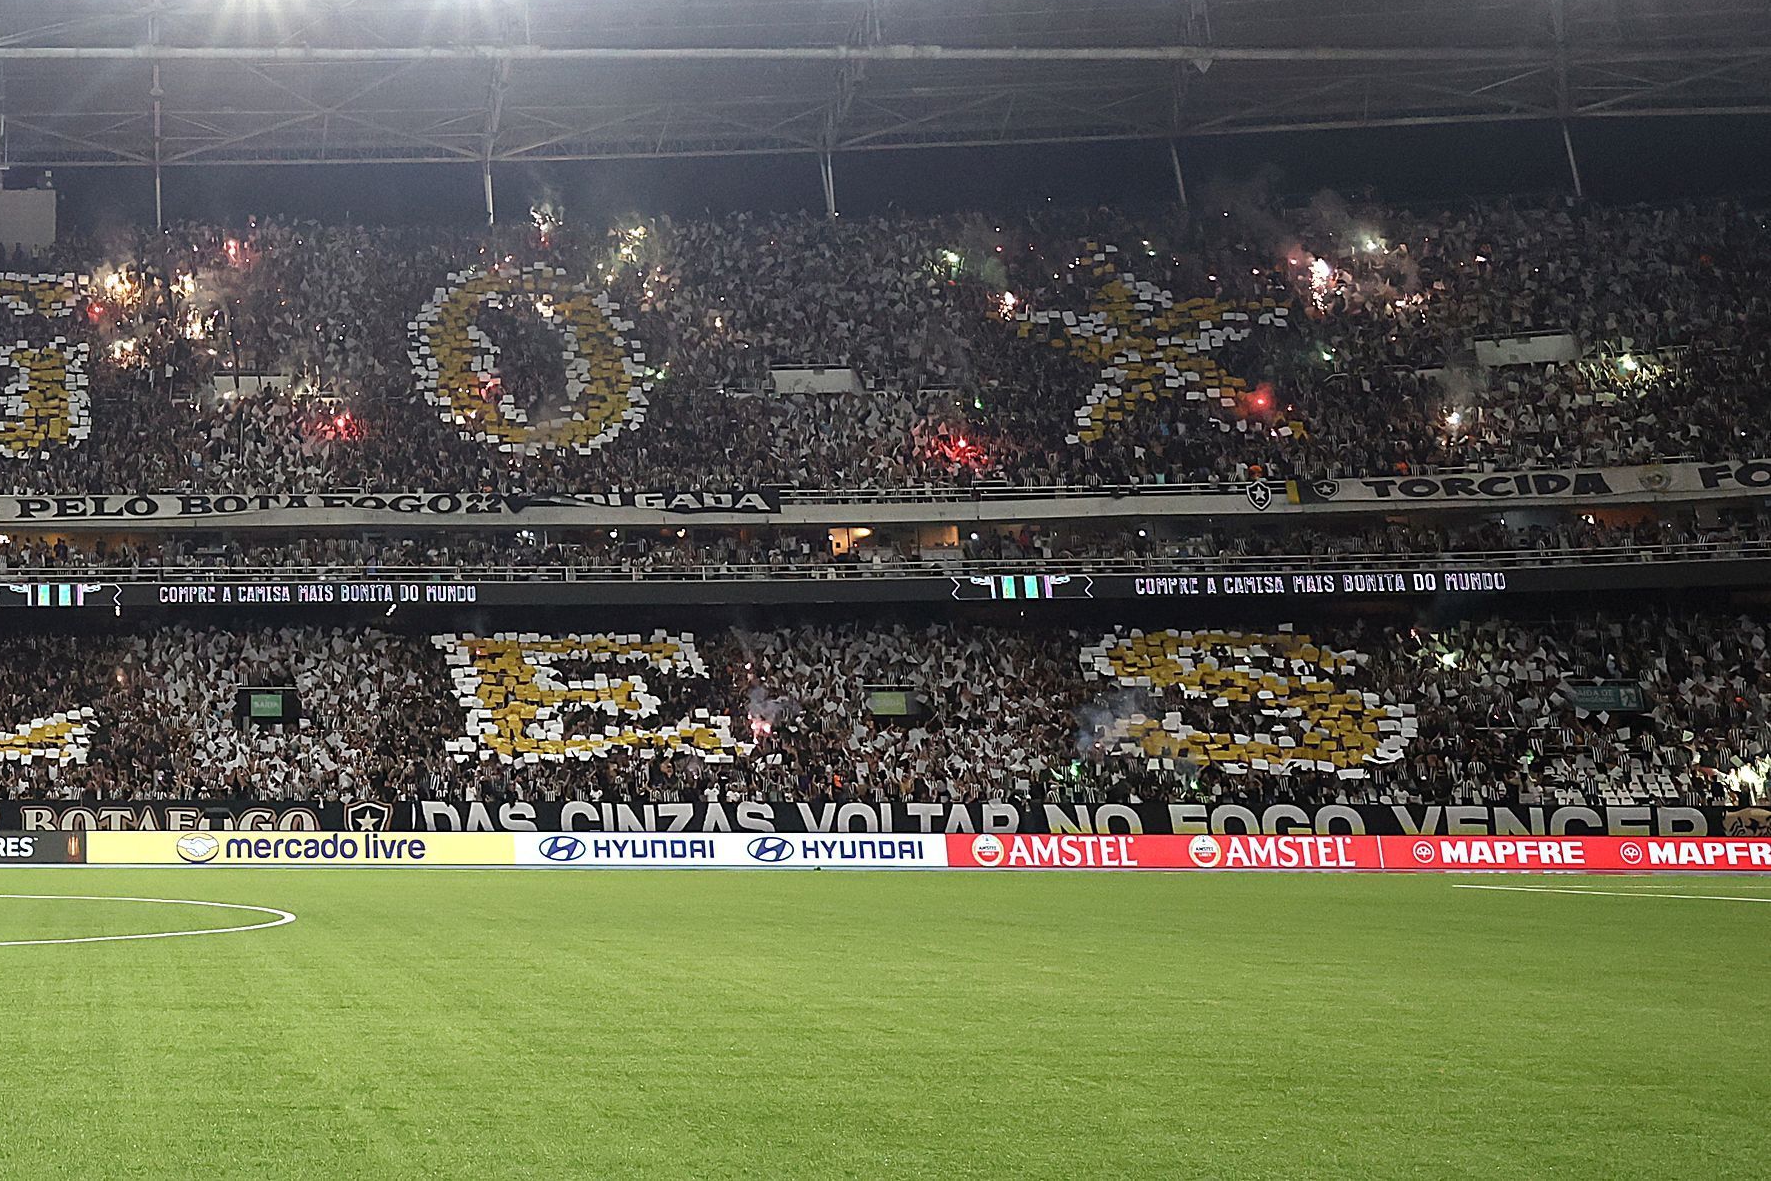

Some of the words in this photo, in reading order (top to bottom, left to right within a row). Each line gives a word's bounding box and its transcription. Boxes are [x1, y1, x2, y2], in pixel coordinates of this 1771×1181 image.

[1366, 473, 1613, 499] TORCIDA
[16, 497, 158, 518] PELO
[159, 585, 216, 603] COMPRE
[221, 585, 232, 603] A
[237, 585, 290, 603] CAMISA
[298, 585, 334, 603] MAIS
[340, 584, 393, 602] BONITA
[399, 584, 419, 602] DO
[426, 584, 477, 602] MUNDO
[1134, 577, 1199, 595] COMPRE
[1207, 577, 1217, 594] A
[1223, 576, 1285, 594] CAMISA
[1292, 575, 1335, 593] MAIS
[1343, 574, 1406, 592] BONITA
[1413, 573, 1436, 591] DO
[1444, 572, 1506, 591] MUNDO
[422, 801, 537, 832] DAS
[560, 802, 777, 832] CINZAS
[1043, 804, 1143, 834] NO
[1169, 804, 1366, 835] FOGO
[227, 834, 358, 859] mercado
[365, 834, 426, 859] livre
[594, 839, 715, 859] HYUNDAI
[803, 840, 924, 860] HYUNDAI
[1008, 836, 1138, 866] AMSTEL
[1226, 836, 1356, 867] AMSTEL
[1440, 841, 1586, 864] MAPFRE
[1648, 841, 1771, 865] MAPFR
